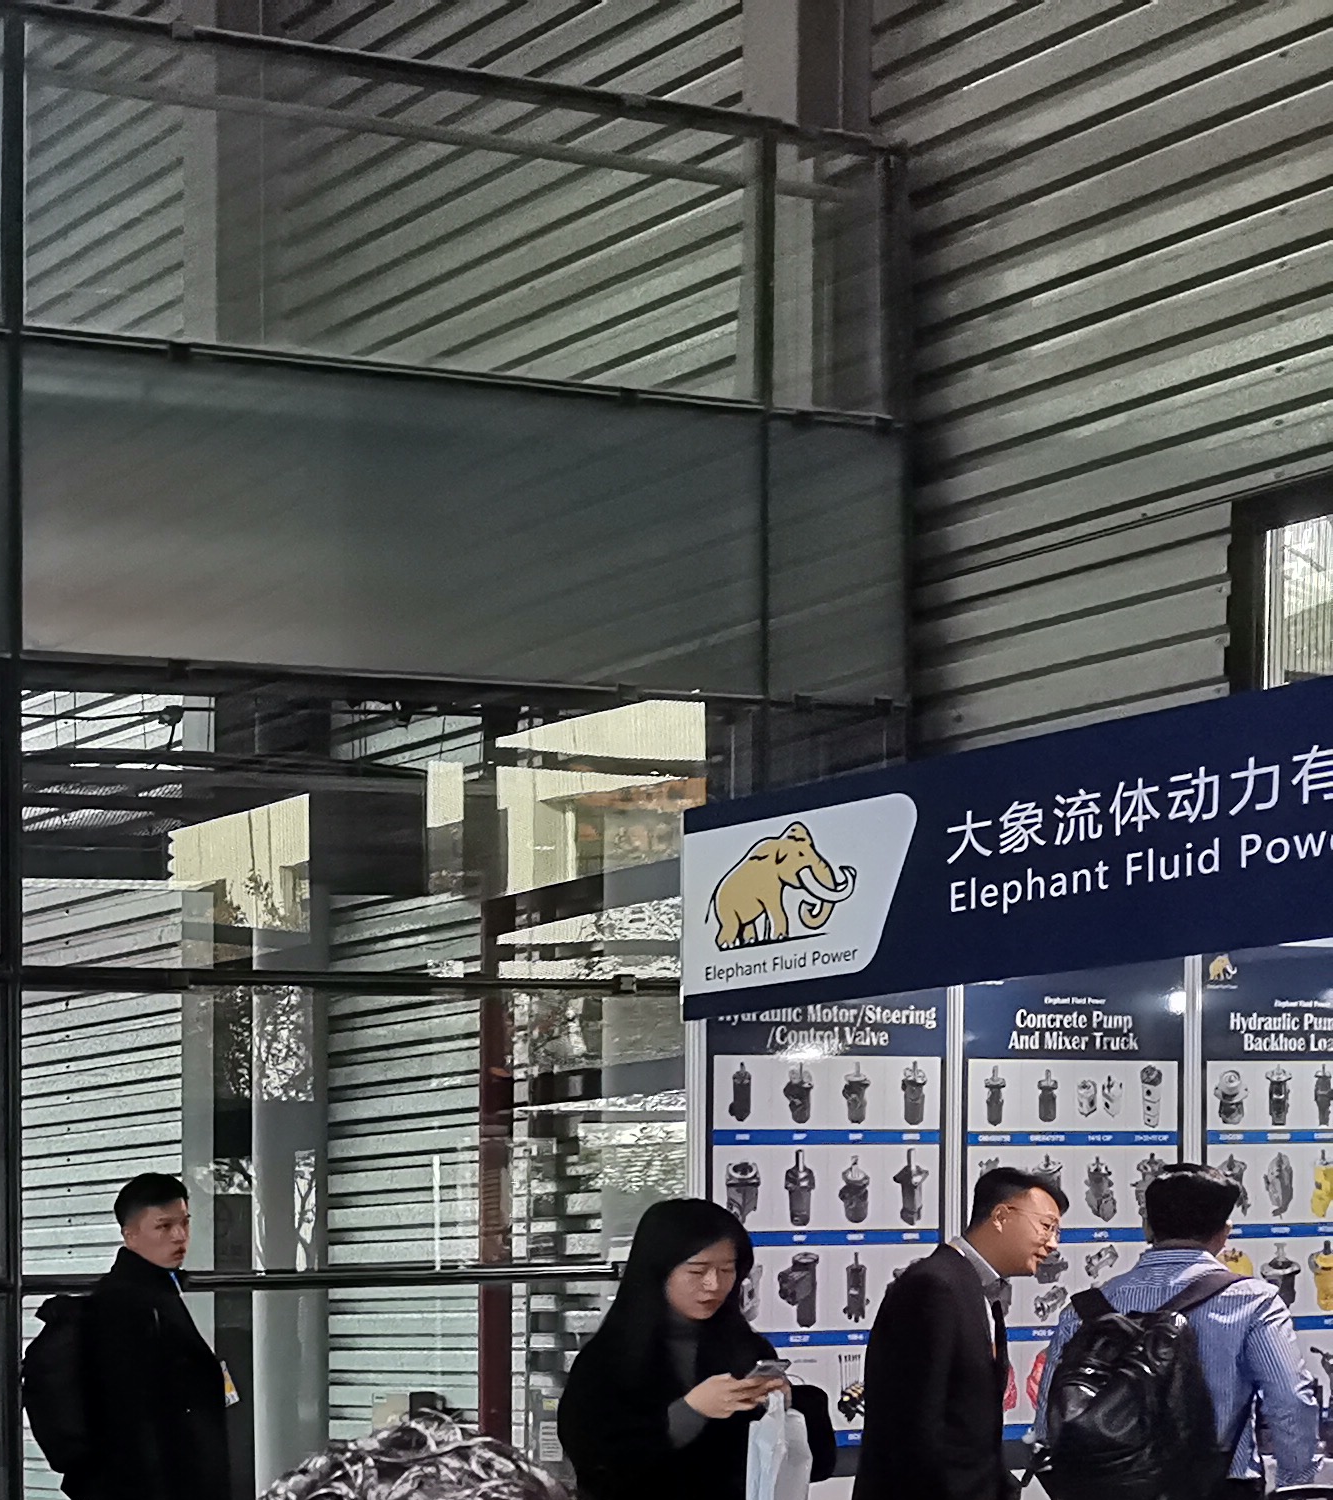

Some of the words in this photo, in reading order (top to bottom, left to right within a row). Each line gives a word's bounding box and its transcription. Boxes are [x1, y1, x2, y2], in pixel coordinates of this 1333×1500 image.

[949, 860, 1109, 914] Elephant
[1125, 837, 1220, 886] Fluid
[1239, 829, 1333, 869] Pow
[704, 959, 768, 983] Elephant
[772, 952, 807, 972] Fluid
[812, 948, 858, 966] Power
[1015, 1008, 1088, 1030] Concrete
[1229, 1012, 1300, 1034] Hydraulic
[844, 1026, 890, 1047] Valve
[1008, 1031, 1040, 1050] And
[1044, 1031, 1089, 1051] Mixer
[1091, 1031, 1139, 1051] Truck
[1243, 1033, 1306, 1052] Backhoe
